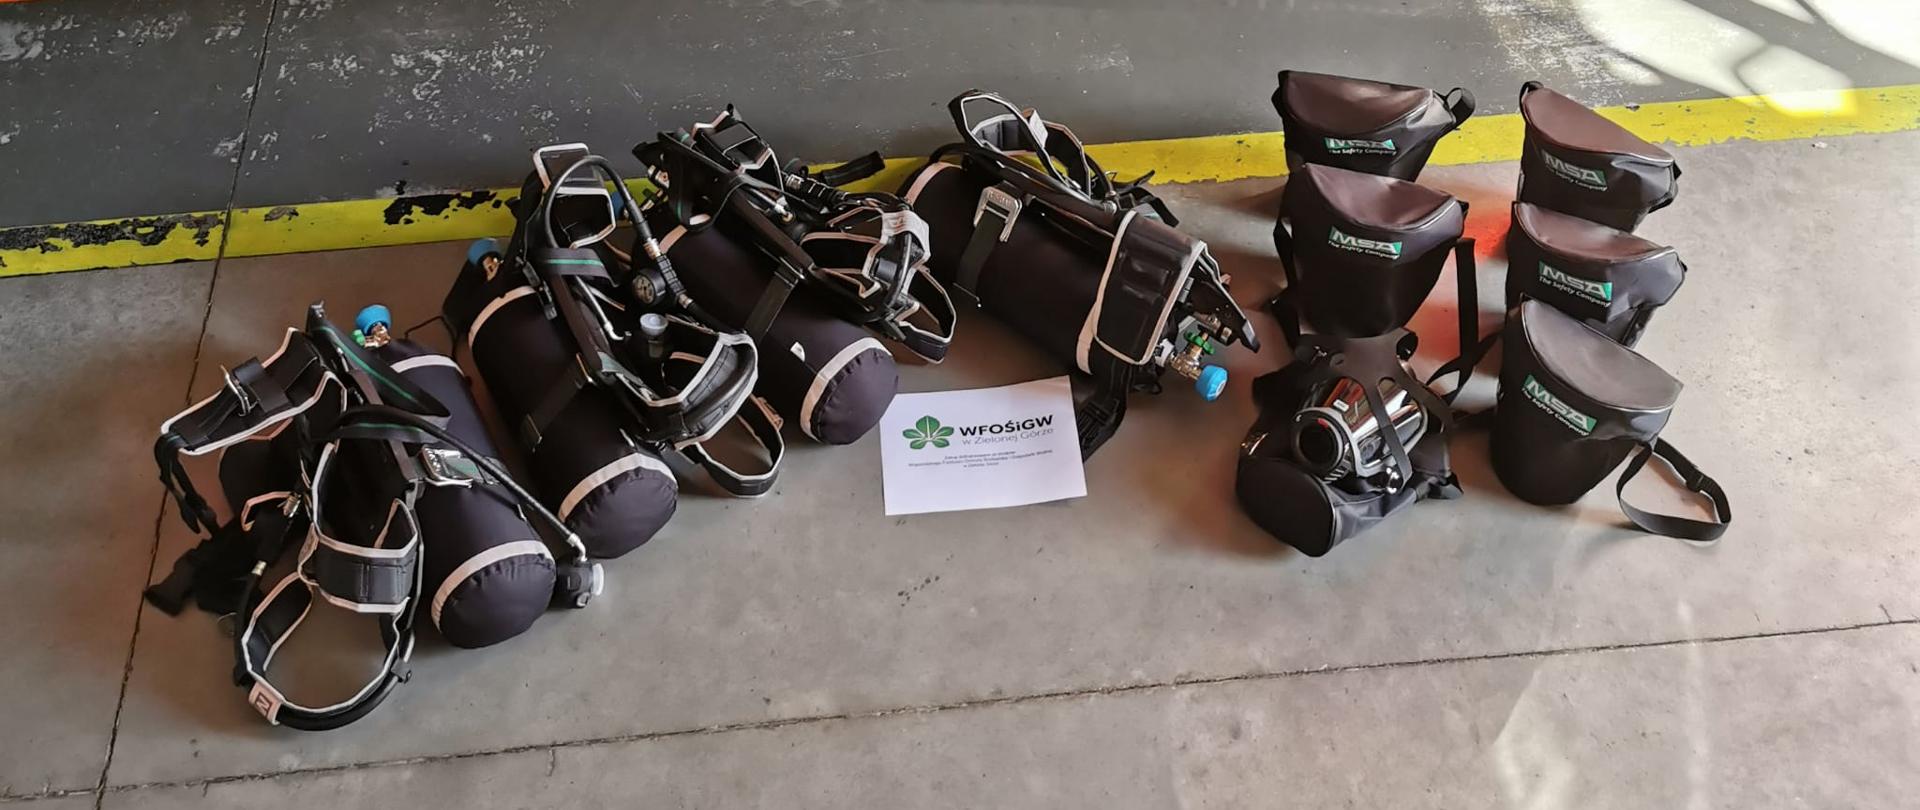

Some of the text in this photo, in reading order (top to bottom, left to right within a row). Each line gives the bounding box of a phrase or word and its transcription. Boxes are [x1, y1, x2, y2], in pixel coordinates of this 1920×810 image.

[1329, 139, 1396, 150] MSA
[1365, 148, 1397, 156] Company
[1543, 151, 1604, 185] MSA
[1333, 230, 1401, 256] MSA
[1365, 248, 1401, 260] Company
[1539, 276, 1612, 308] The Safety Company
[1543, 265, 1607, 300] MSA
[1526, 380, 1590, 432] MSA
[1532, 398, 1555, 415] Safety
[1554, 413, 1590, 436] Company
[959, 414, 1053, 437] WFOŚiGW
[961, 427, 1054, 446] w Zielonej Górze
